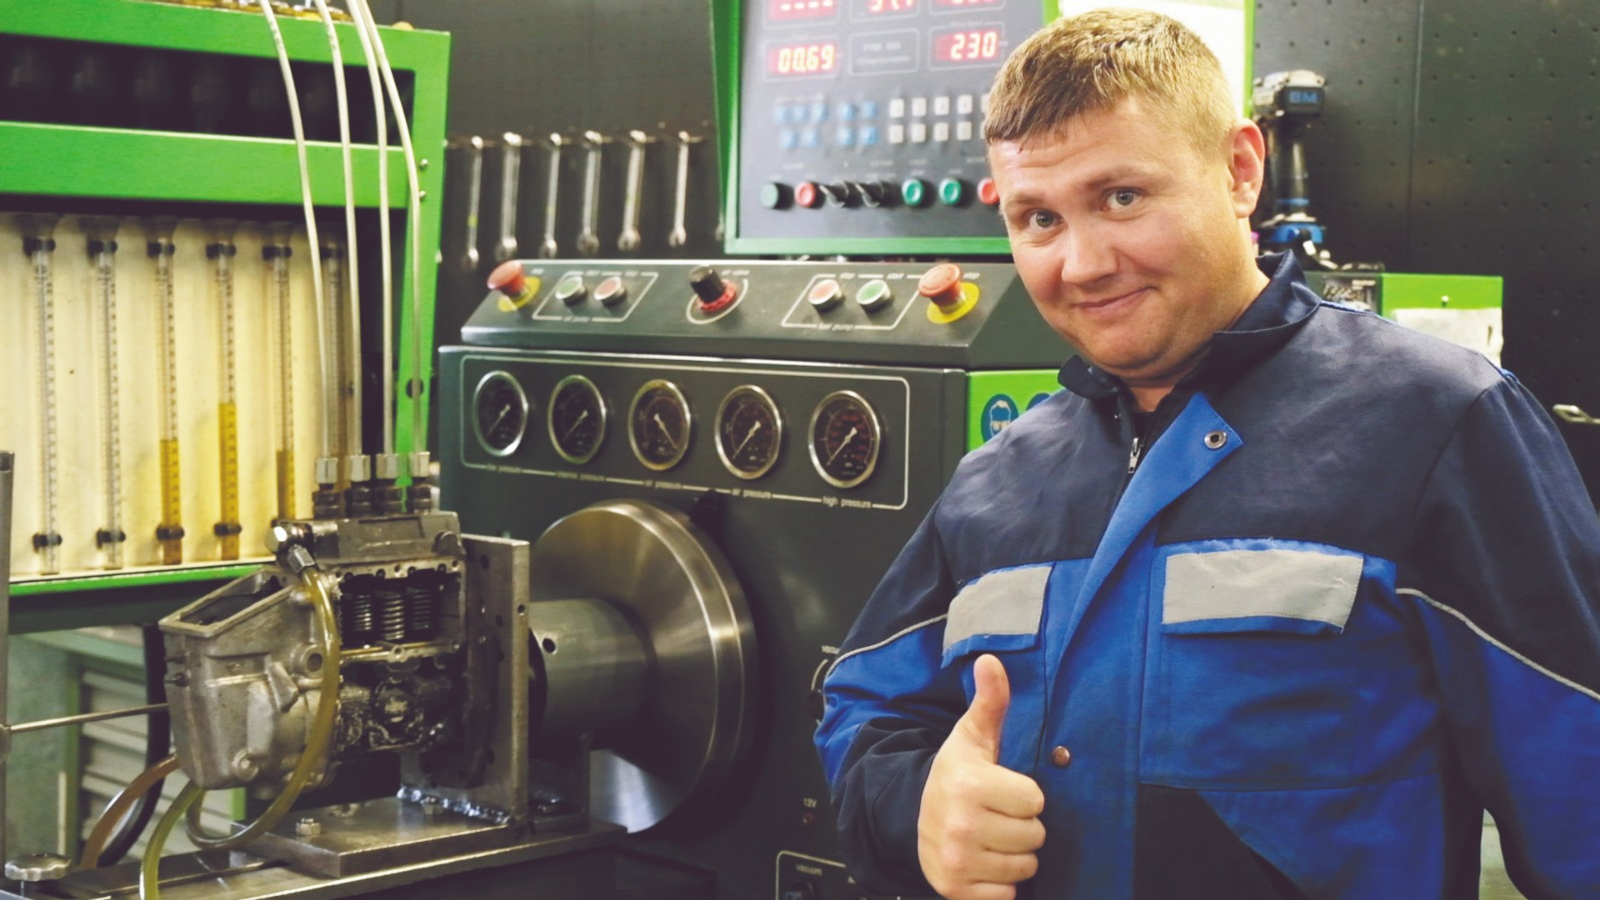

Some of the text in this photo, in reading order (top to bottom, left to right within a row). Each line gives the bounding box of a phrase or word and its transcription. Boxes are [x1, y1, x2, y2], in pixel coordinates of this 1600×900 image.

[950, 32, 998, 60] 230
[832, 323, 854, 333] pump
[743, 489, 771, 499] pressure
[822, 496, 872, 509] high pressure
[803, 797, 817, 808] 12V
[795, 864, 823, 877] vacuum
